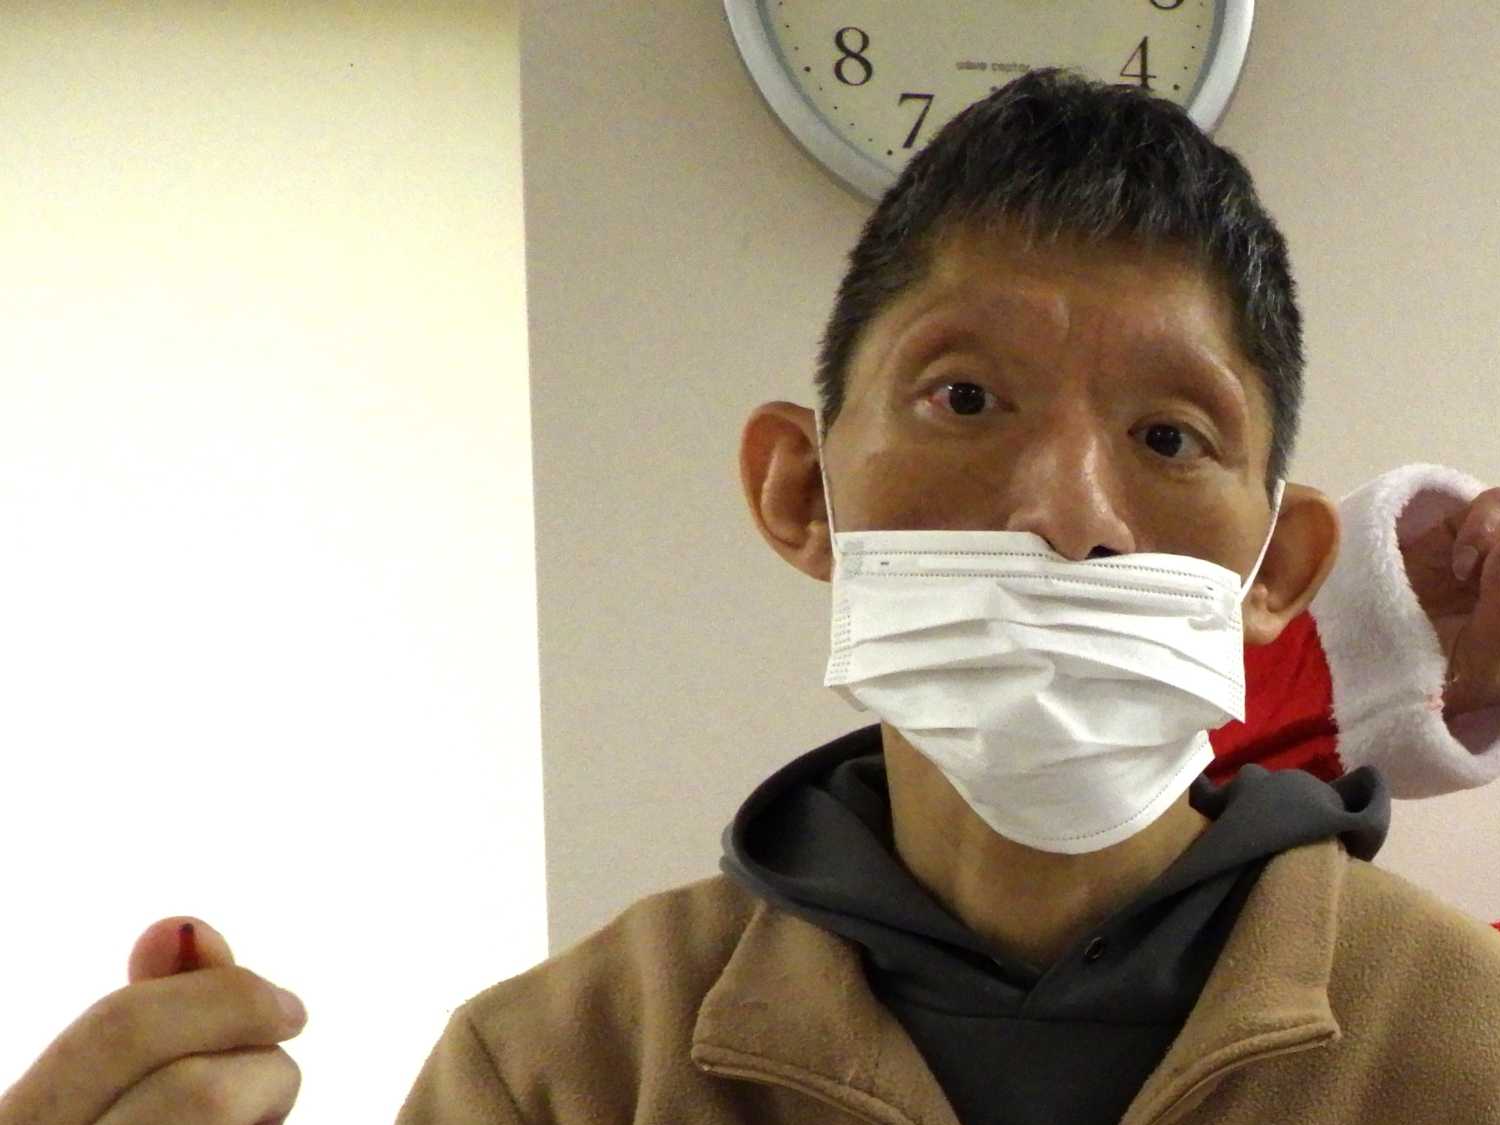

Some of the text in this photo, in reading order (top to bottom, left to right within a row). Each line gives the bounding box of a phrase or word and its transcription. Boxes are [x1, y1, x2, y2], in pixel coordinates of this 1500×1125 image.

[834, 27, 874, 86] 8
[1120, 36, 1157, 90] 4
[898, 92, 935, 149] 7
